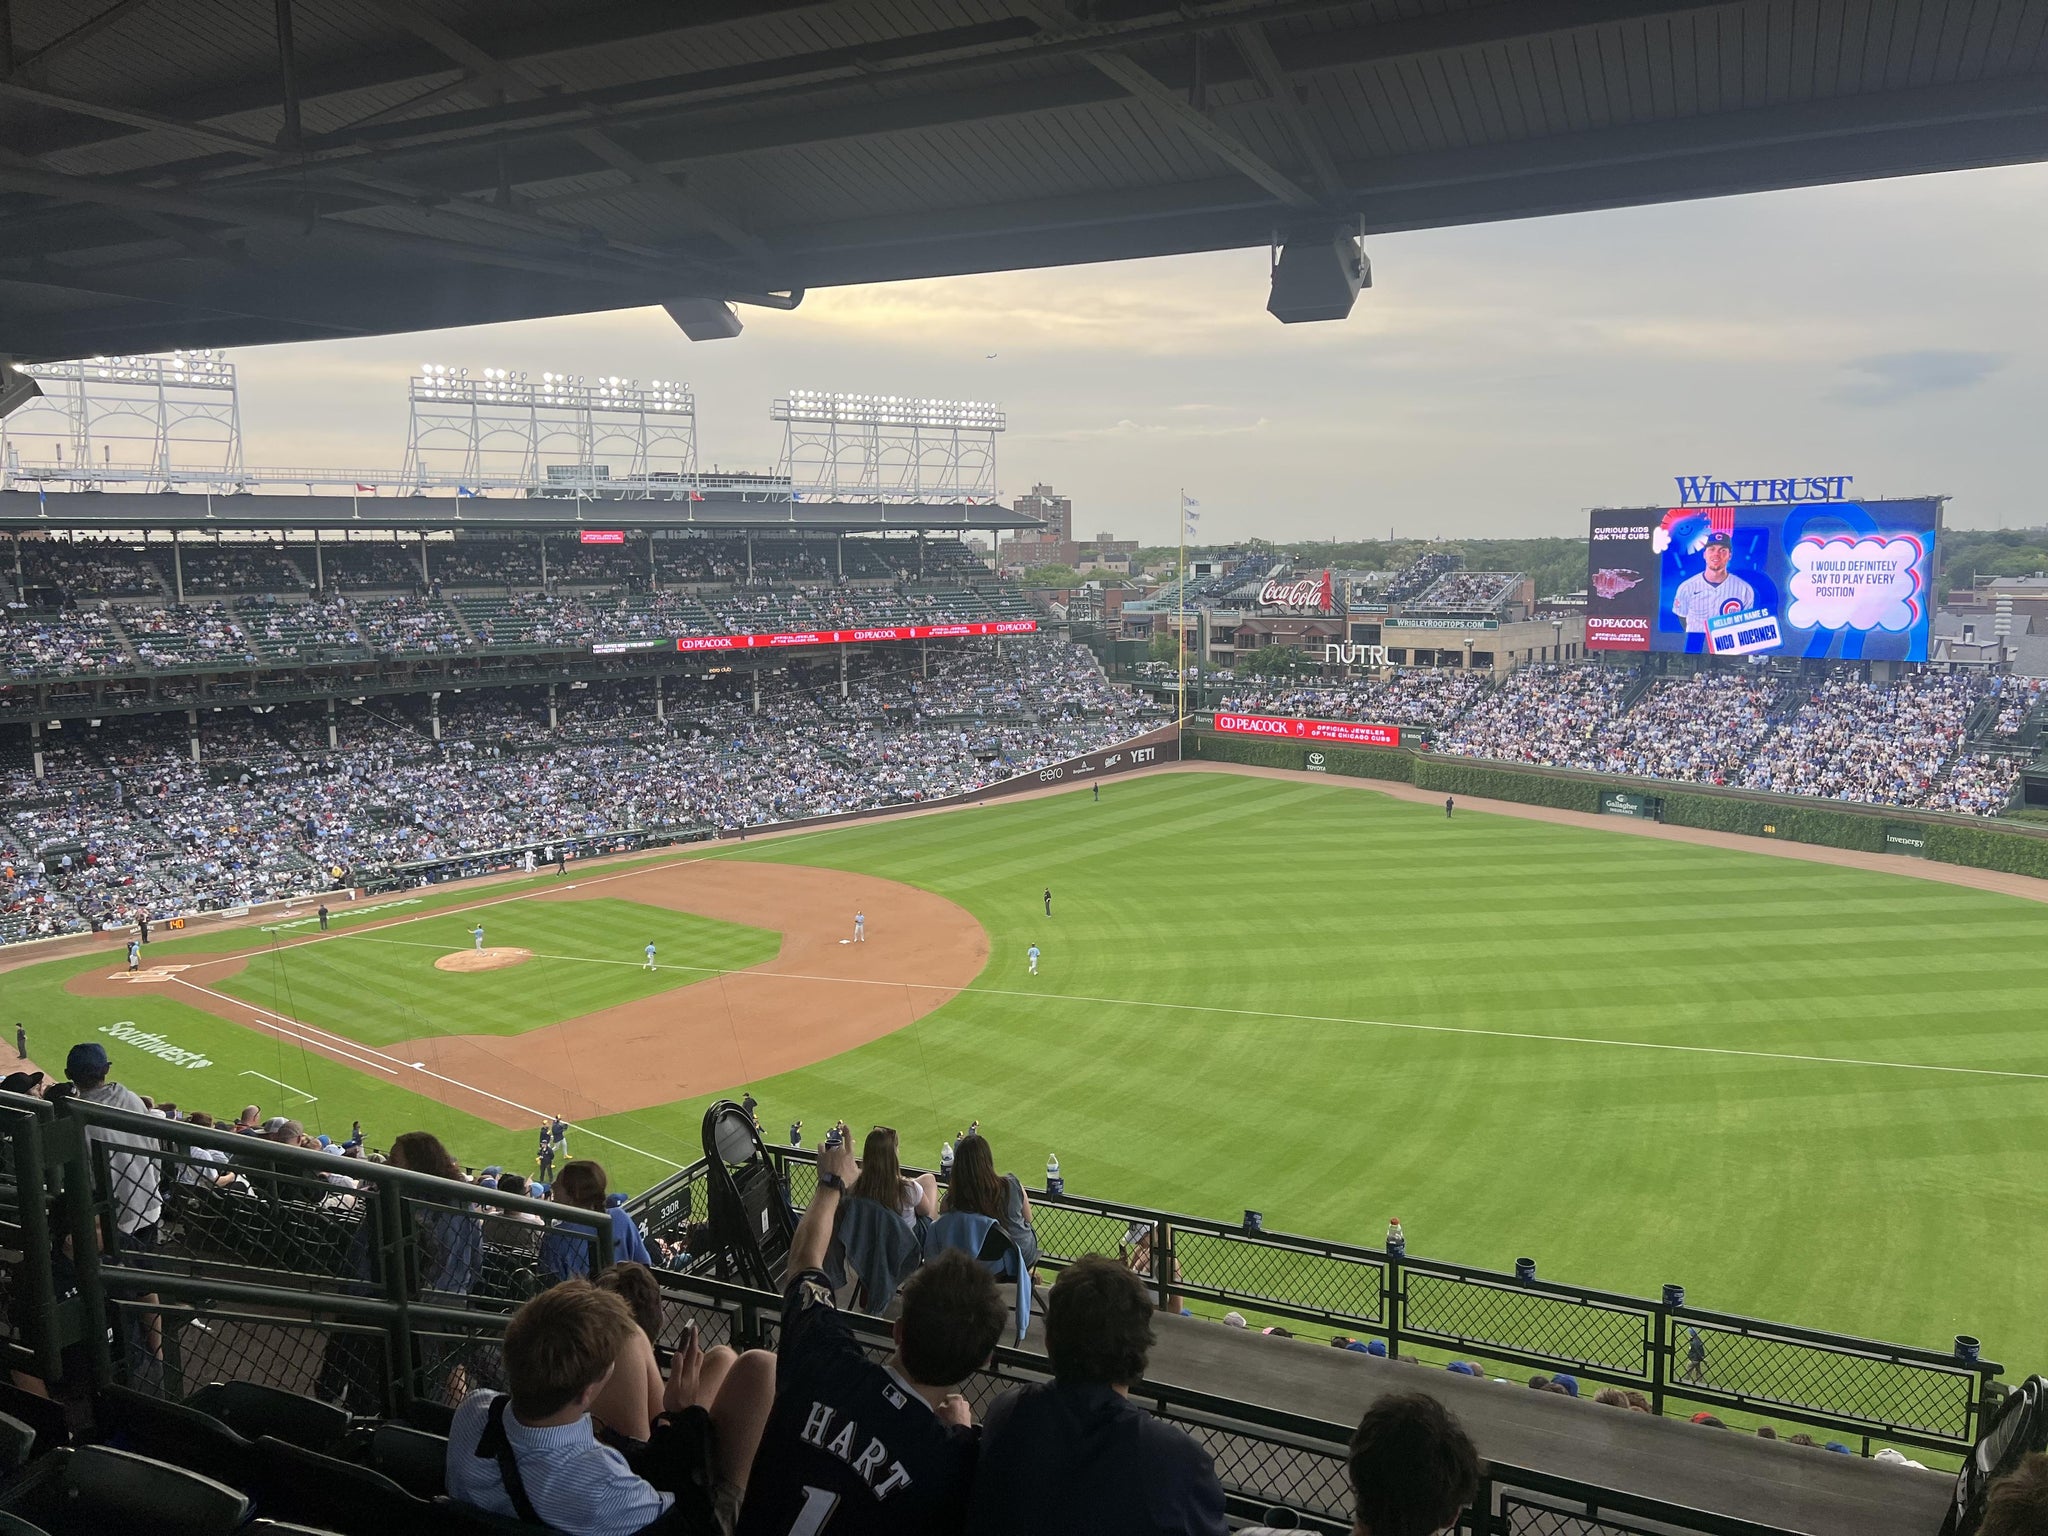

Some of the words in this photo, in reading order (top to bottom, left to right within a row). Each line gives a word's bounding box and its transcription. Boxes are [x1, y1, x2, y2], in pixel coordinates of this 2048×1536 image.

[1675, 475, 1853, 505] WINTRUST
[1811, 561, 1814, 571] I
[1816, 560, 1846, 571] WOULD
[1848, 560, 1897, 571] DEFINITELY
[1811, 574, 1828, 584] SAY
[1830, 574, 1841, 584] TO
[1843, 574, 1864, 584] PLAY
[1866, 574, 1895, 584] EVERY
[1816, 586, 1855, 597] POSITION
[1734, 614, 1743, 623] MY
[1744, 610, 1761, 621] NAME
[1762, 608, 1769, 616] IS
[1006, 623, 1033, 632] PEACOCK
[1588, 618, 1602, 628] CD
[1602, 618, 1649, 629] PEACOCK
[865, 629, 897, 639] PEACOCK
[1714, 633, 1735, 652] NICO
[1737, 624, 1777, 647] HOERNER
[694, 638, 732, 649] PEACOCK
[1220, 716, 1236, 730] CD
[1237, 718, 1288, 734] PEACOCK
[1317, 725, 1348, 733] OFFICIAL
[1350, 727, 1385, 736] JEWELER
[1338, 733, 1369, 741] CHICAGO
[1371, 735, 1391, 743] CUBS
[1130, 747, 1155, 764] YETI
[1040, 767, 1063, 781] eero
[1605, 800, 1638, 810] Gallagher
[1886, 834, 1925, 848] Invenergy
[98, 1021, 206, 1066] Southwest
[800, 1401, 913, 1501] HART
